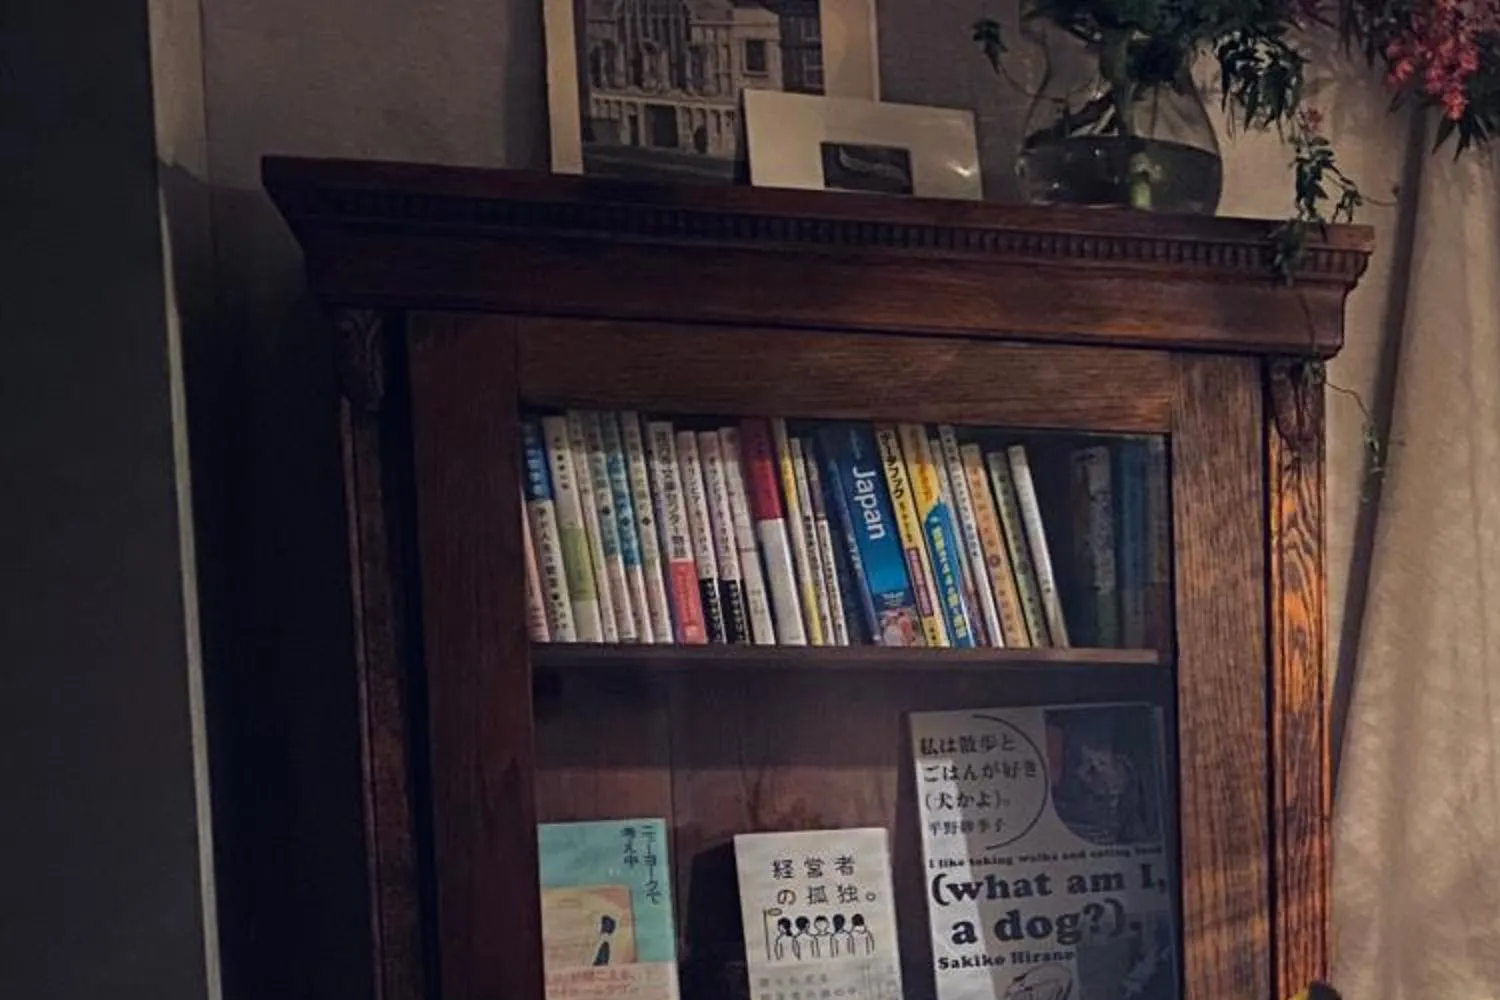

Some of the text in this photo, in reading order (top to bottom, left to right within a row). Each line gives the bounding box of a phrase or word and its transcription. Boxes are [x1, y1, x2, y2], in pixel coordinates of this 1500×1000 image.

[852, 465, 887, 541] Japan
[772, 855, 855, 880] 経営者
[777, 884, 877, 905] の孤独。
[932, 872, 1052, 906] (what
[1067, 870, 1125, 895] am
[951, 919, 977, 945] a
[938, 952, 1006, 970] Sakiko
